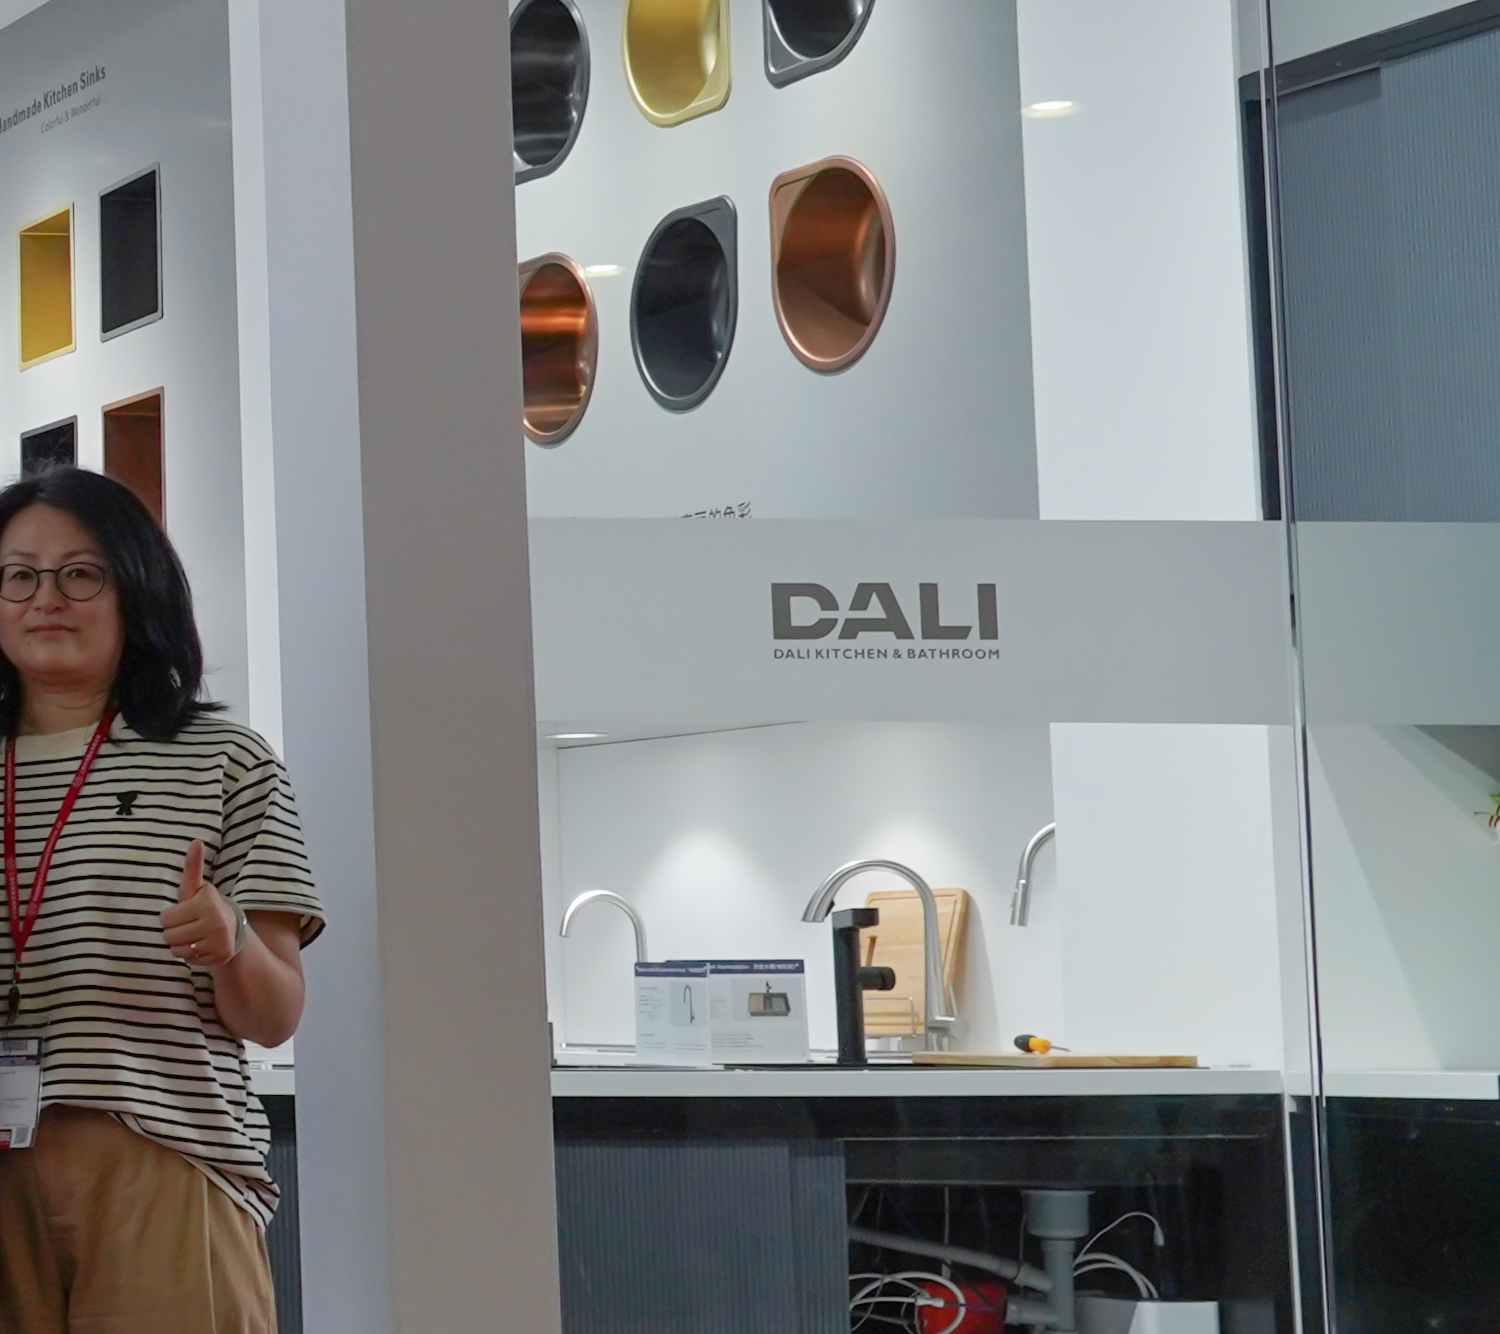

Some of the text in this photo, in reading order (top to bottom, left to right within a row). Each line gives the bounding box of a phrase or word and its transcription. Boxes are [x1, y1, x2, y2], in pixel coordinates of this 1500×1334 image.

[43, 81, 78, 110] Kitchen
[80, 65, 106, 90] Sinks
[771, 582, 999, 640] DALI
[773, 648, 1000, 659] DALI KITCHEN & BATHROOM
